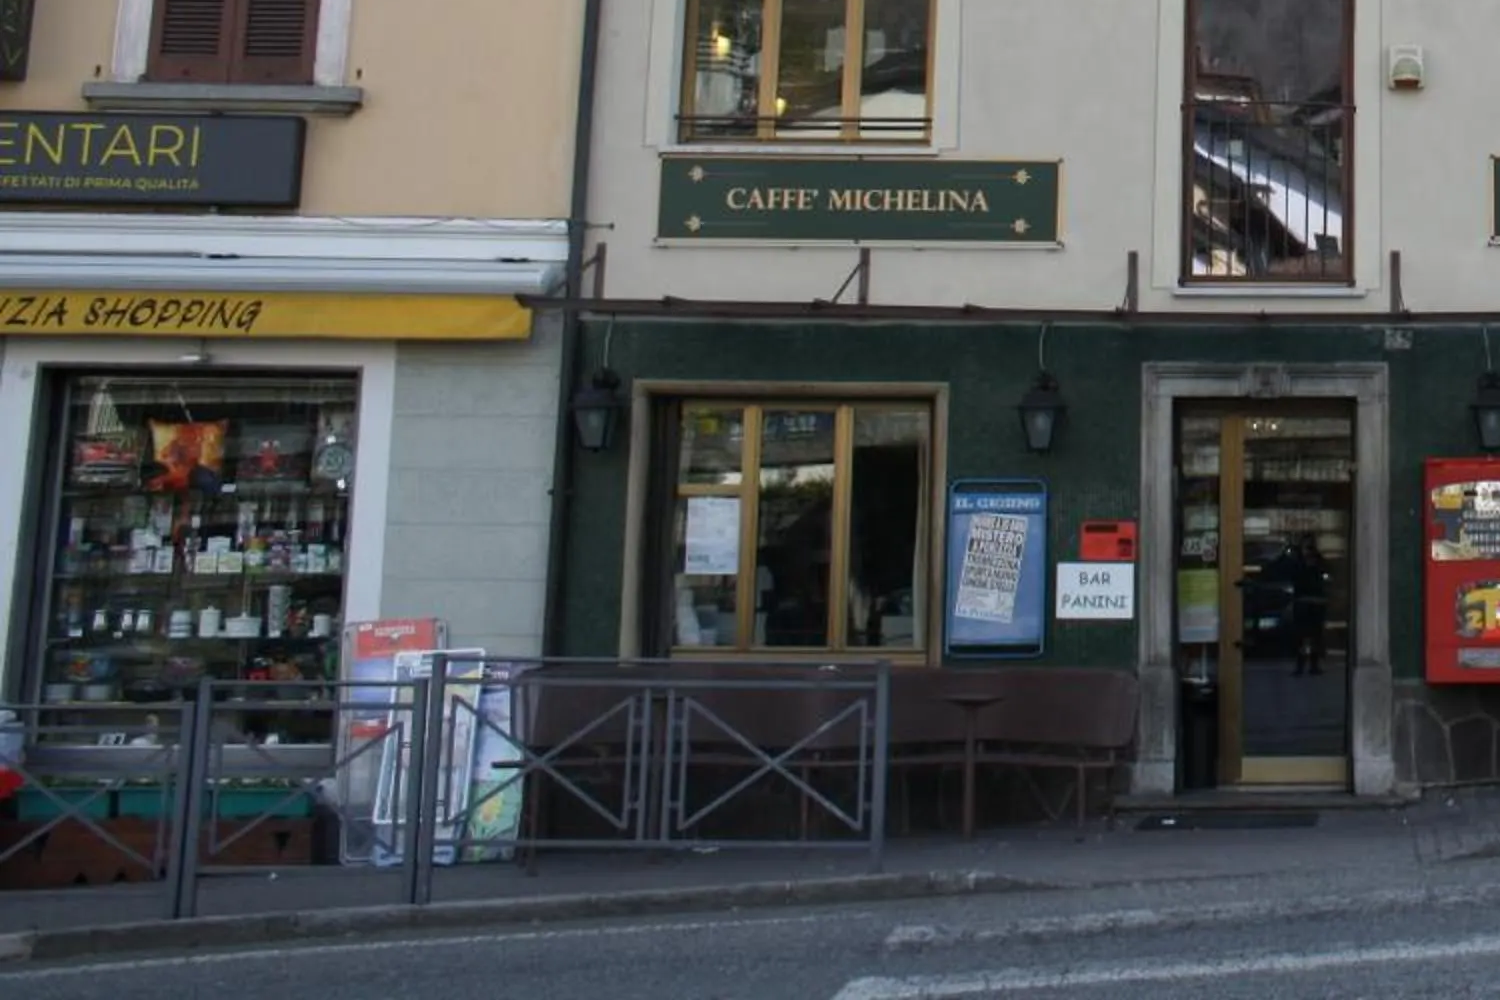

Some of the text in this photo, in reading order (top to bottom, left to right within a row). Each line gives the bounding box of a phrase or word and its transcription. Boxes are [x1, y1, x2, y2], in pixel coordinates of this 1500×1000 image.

[726, 187, 990, 212] CAFFE' MICHELINA
[83, 296, 263, 333] SHOPPING
[1078, 571, 1111, 585] BAR
[1060, 593, 1129, 609] PANINI
